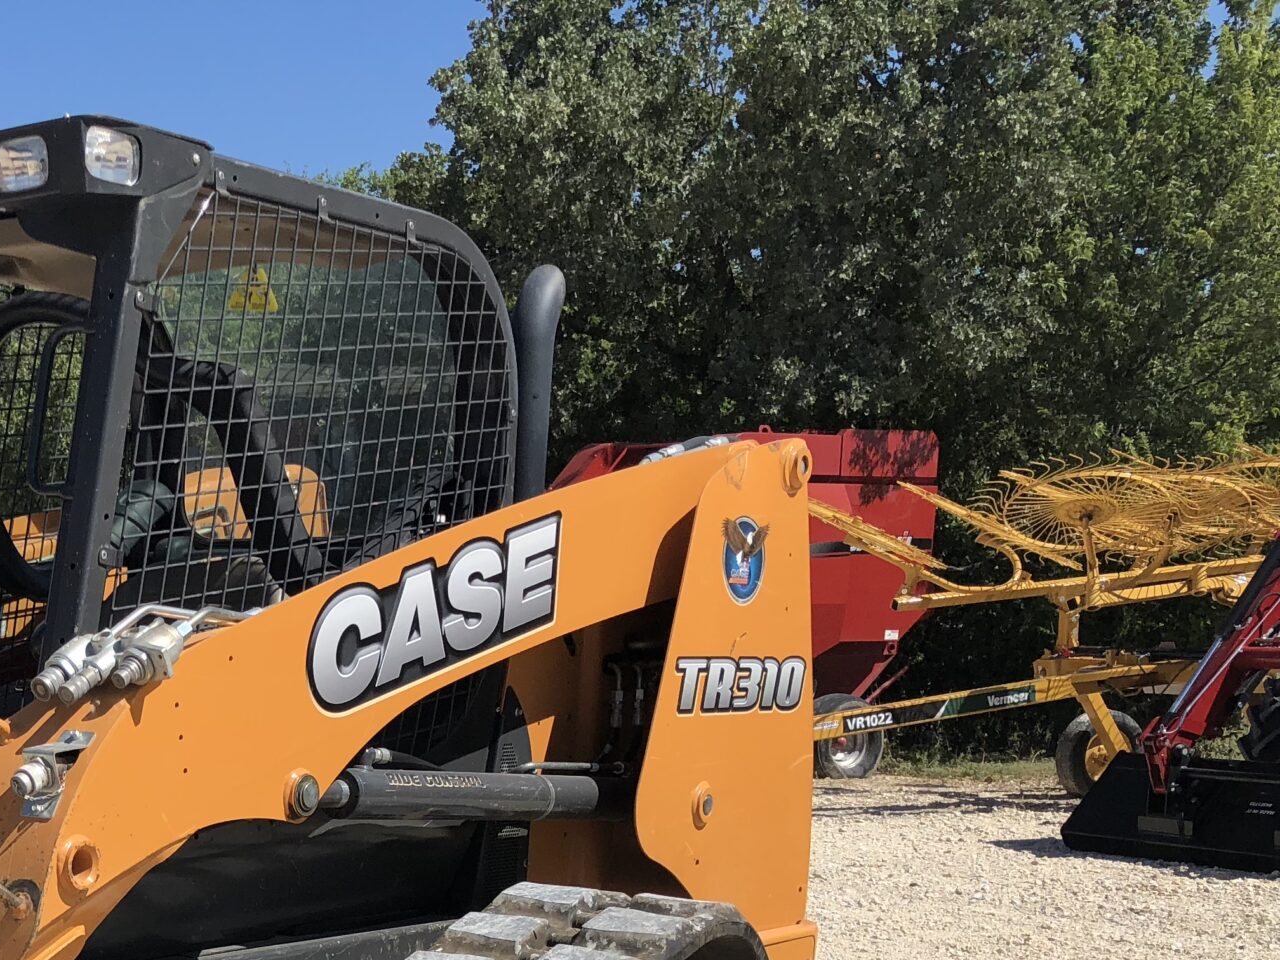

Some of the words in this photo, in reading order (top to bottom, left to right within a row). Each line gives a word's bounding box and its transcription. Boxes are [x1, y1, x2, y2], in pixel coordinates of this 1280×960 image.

[308, 513, 558, 706] CASE
[676, 656, 807, 715] TR310
[987, 692, 1029, 707] Vermeer
[846, 712, 894, 731] VR1022
